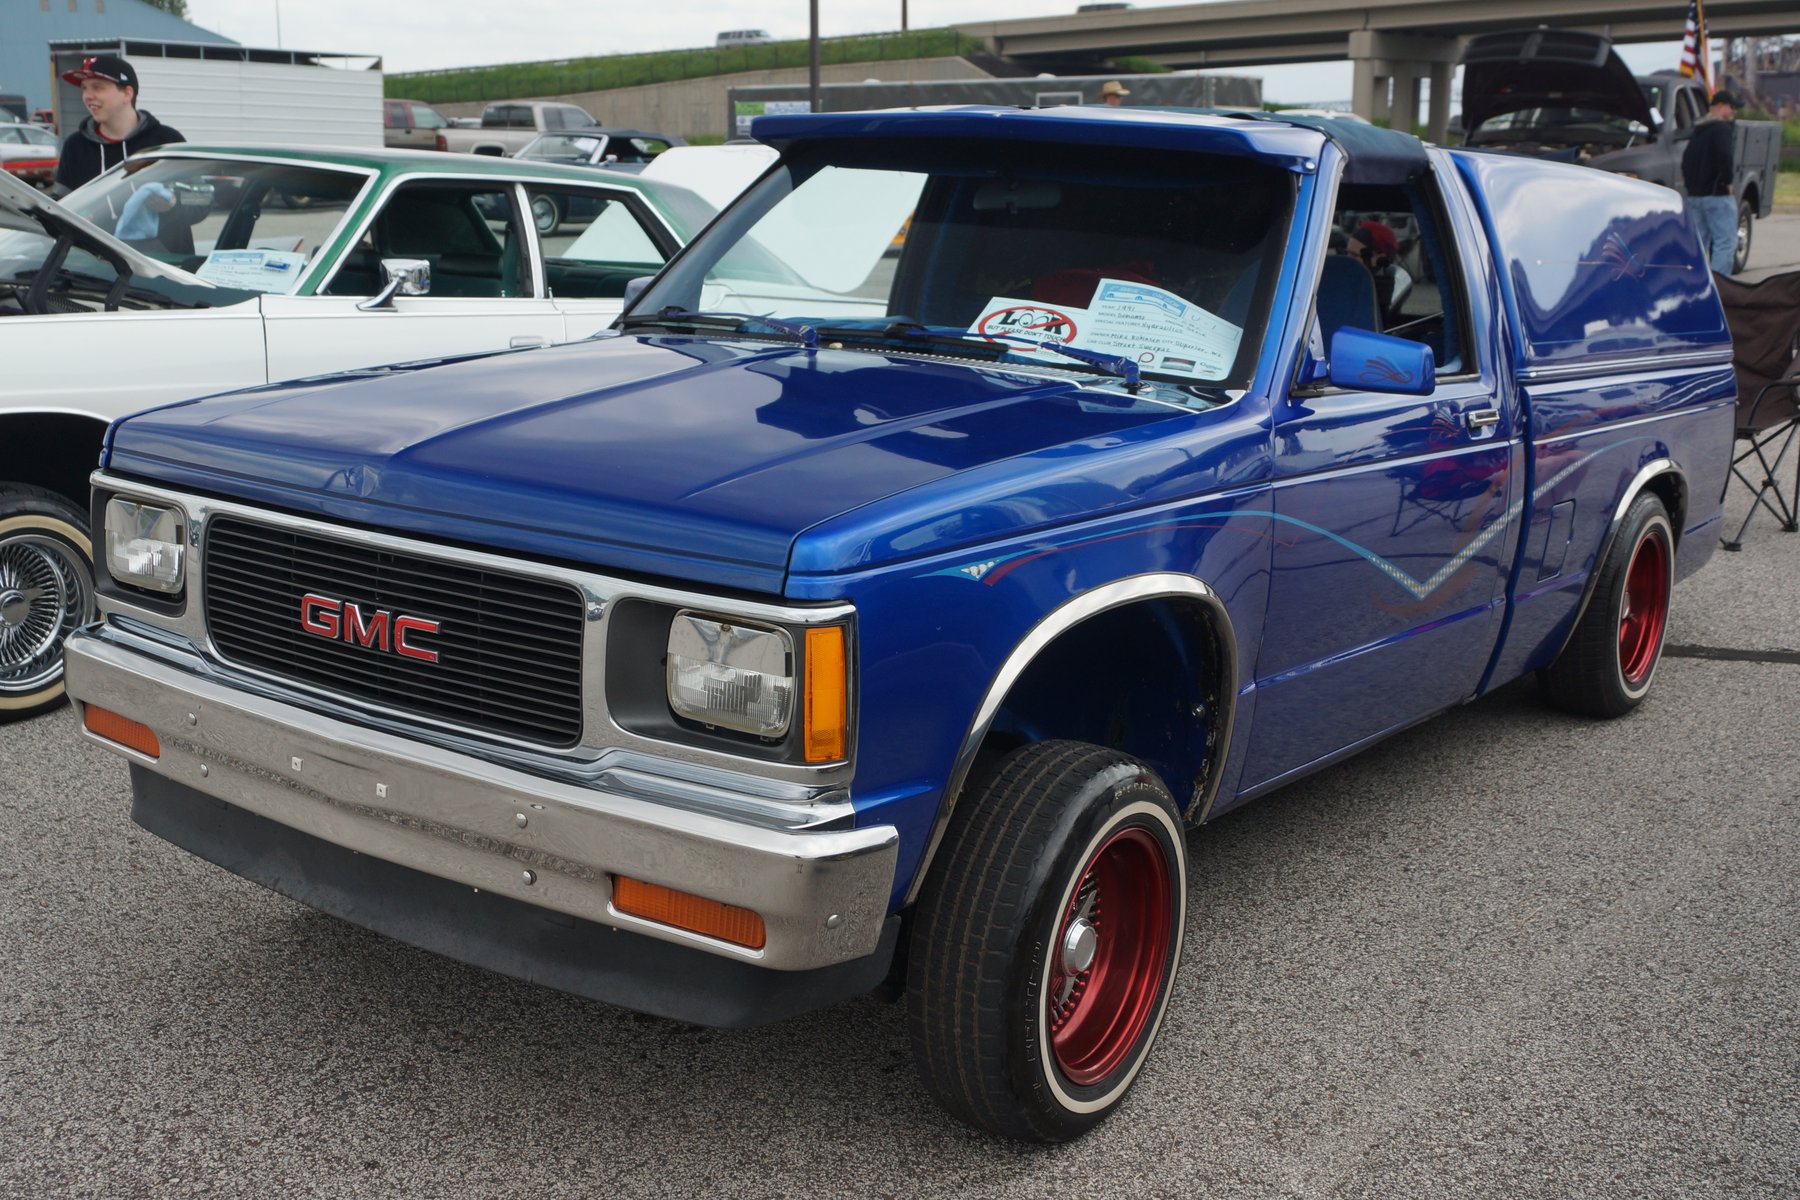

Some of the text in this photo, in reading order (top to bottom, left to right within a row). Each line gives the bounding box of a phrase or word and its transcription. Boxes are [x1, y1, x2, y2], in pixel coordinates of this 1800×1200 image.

[1117, 304, 1136, 312] 1991
[1001, 326, 1024, 334] PLEASE
[1043, 333, 1065, 341] TOUCH
[301, 593, 440, 663] GMC
